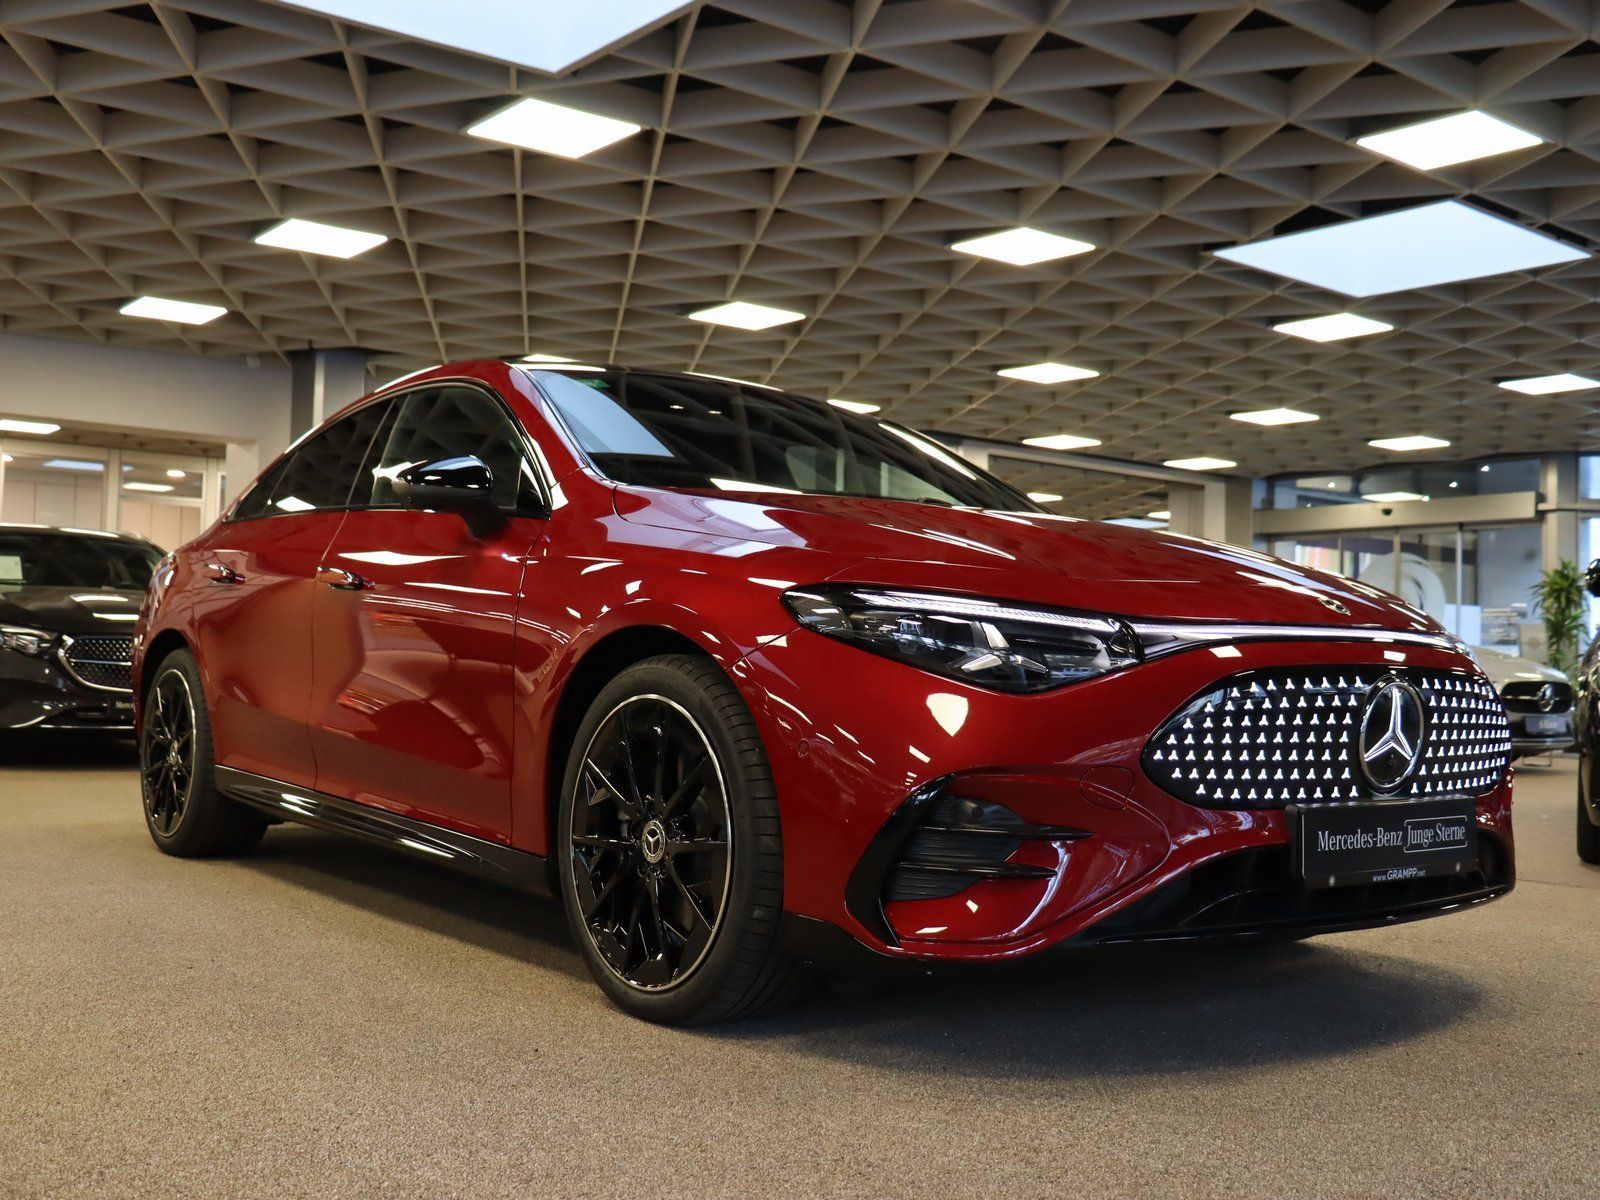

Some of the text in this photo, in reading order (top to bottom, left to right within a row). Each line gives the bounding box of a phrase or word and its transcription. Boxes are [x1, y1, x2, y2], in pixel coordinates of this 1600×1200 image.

[1317, 822, 1466, 852] Mercedes-Benz Junge Sterne
